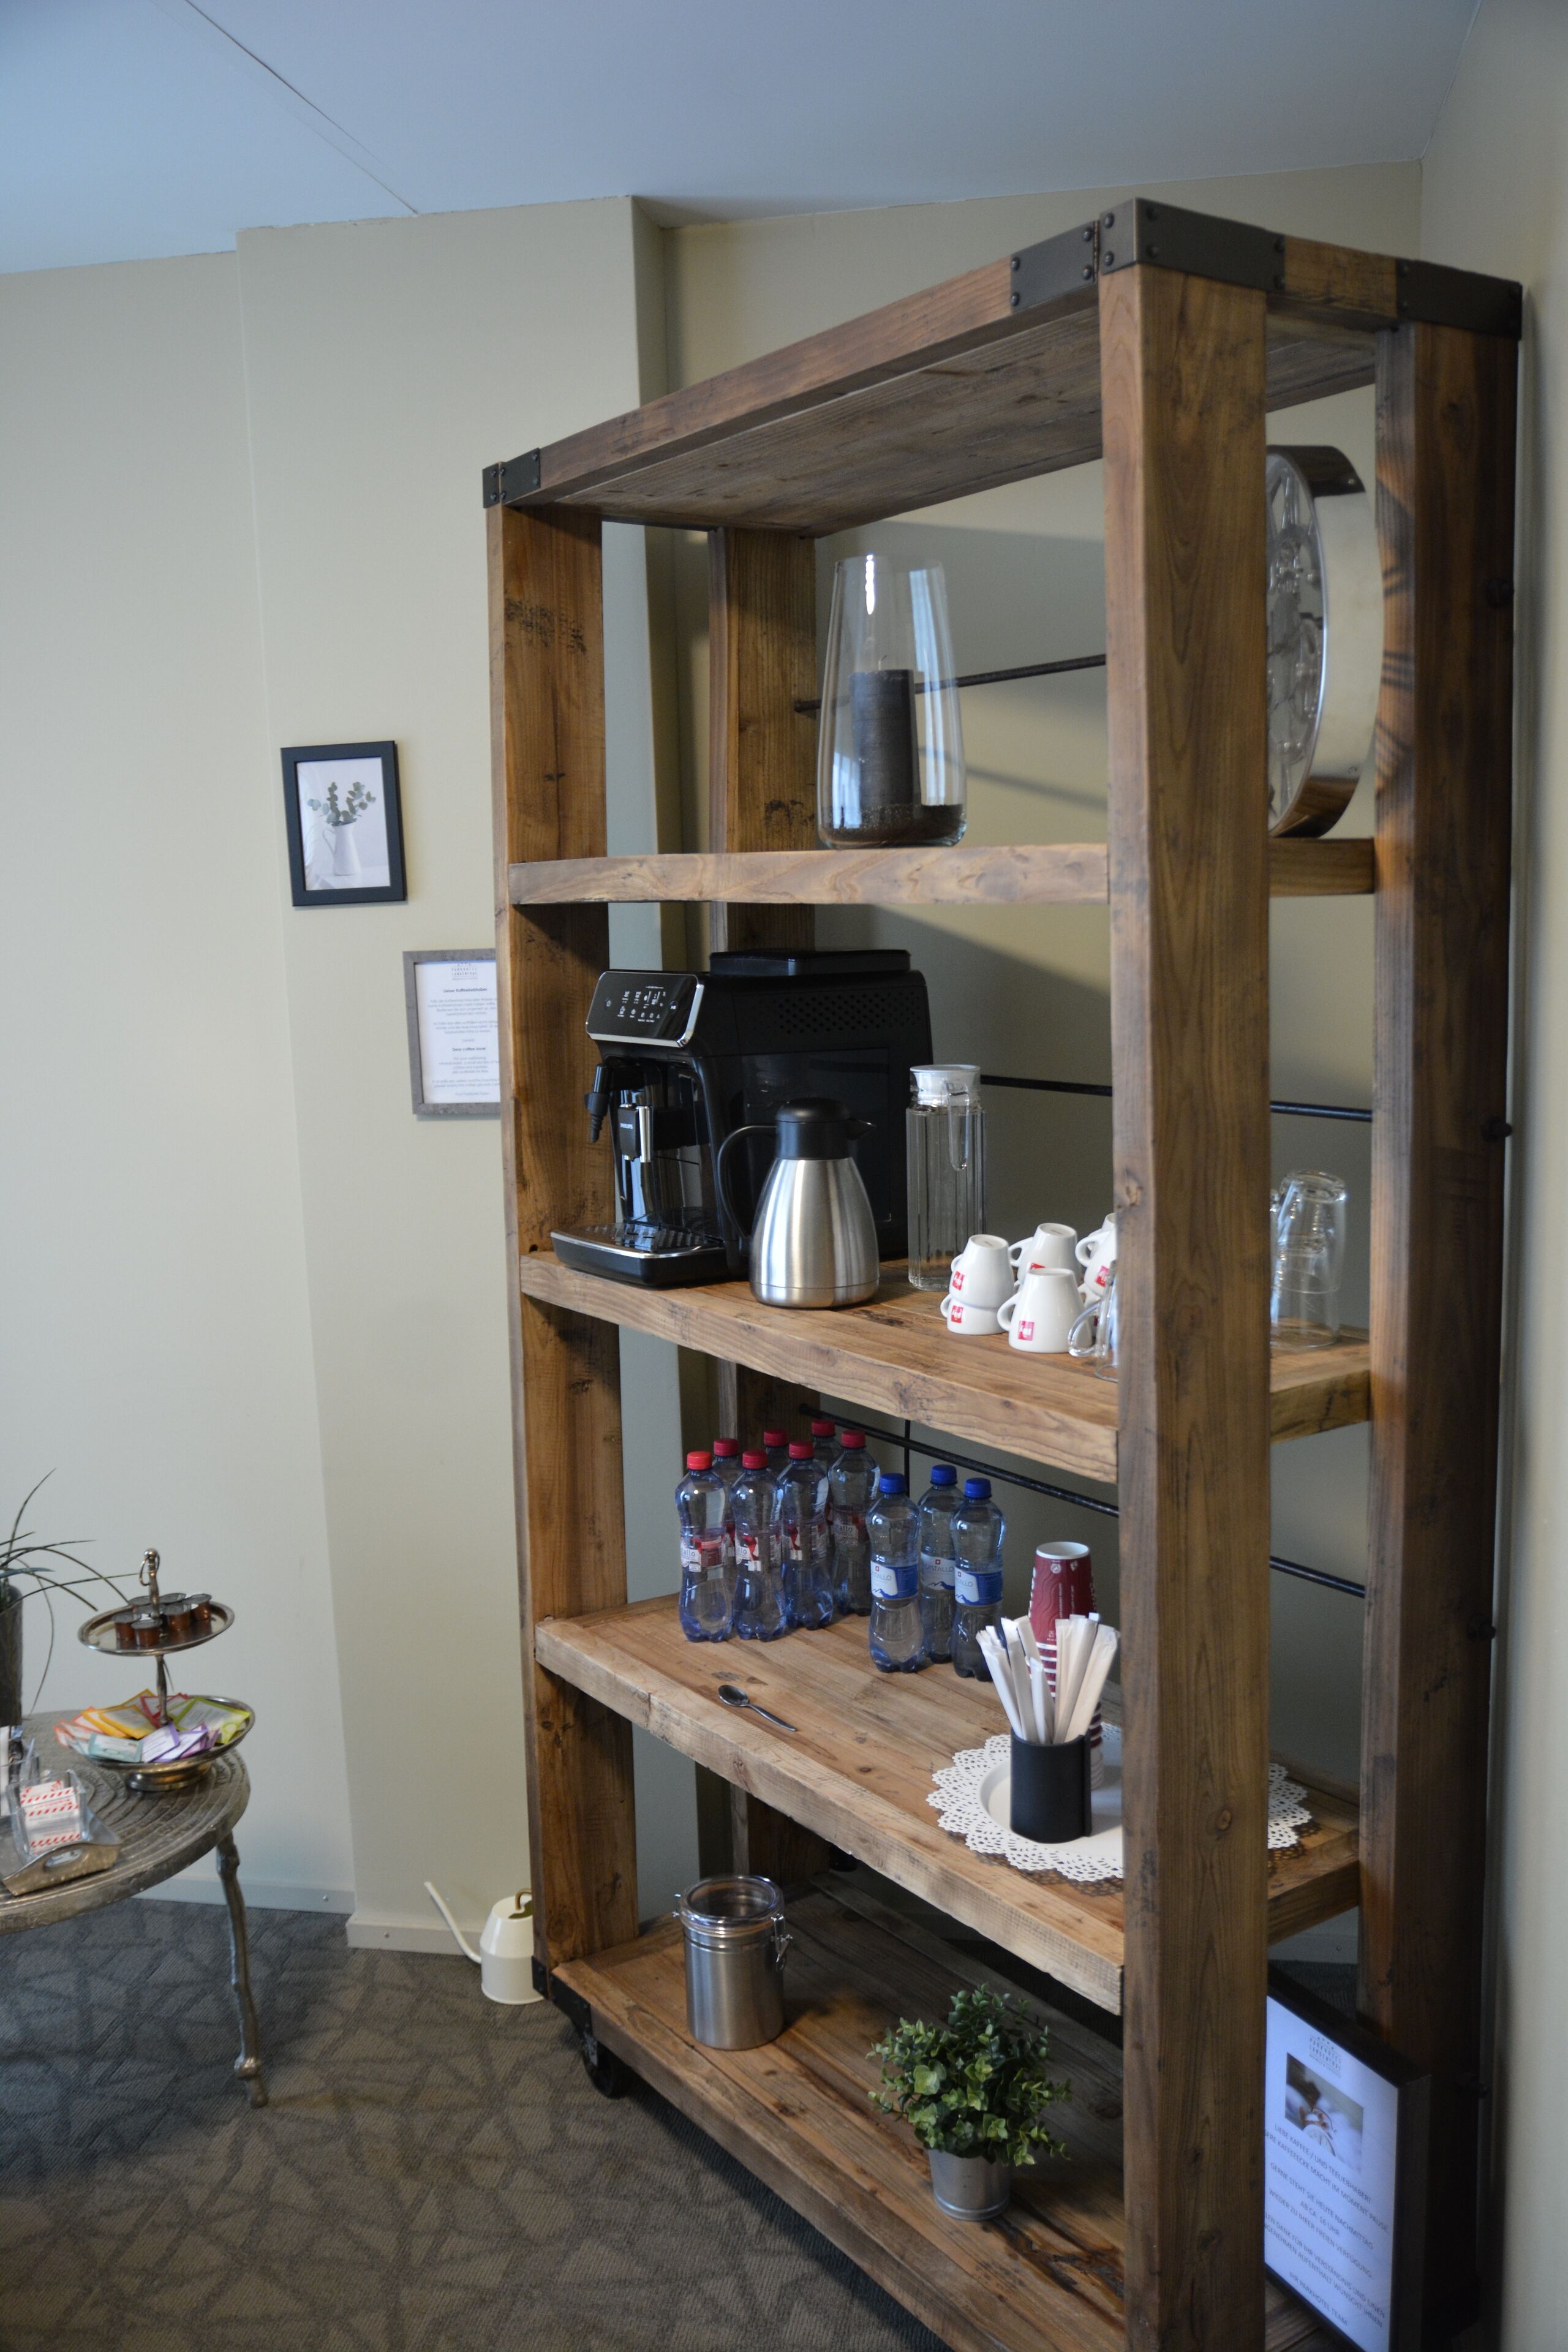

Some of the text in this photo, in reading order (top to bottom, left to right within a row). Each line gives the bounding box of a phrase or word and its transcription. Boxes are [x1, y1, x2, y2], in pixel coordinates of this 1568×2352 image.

[1275, 2123, 1288, 2139] LIEBE
[1314, 2155, 1328, 2169] UND
[1269, 2188, 1289, 2209] WIEDER
[1290, 2206, 1298, 2216] ZU
[1298, 2212, 1314, 2230] IHRER
[1315, 2226, 1335, 2247] FREIEN
[1270, 2162, 1288, 2180] GERNE
[1289, 2177, 1305, 2195] STEHT
[1316, 2198, 1334, 2218] HEUTE
[1335, 2214, 1373, 2250] NACHMITTAG
[1300, 2201, 1308, 2211] AB
[1319, 2216, 1327, 2226] 16
[1327, 2222, 1340, 2236] UHR
[1311, 2166, 1330, 2186] MACHT
[1332, 2184, 1340, 2193] IM
[1341, 2190, 1368, 2216] MOMENT
[1276, 2221, 1291, 2239] DANK
[1303, 2244, 1314, 2256] IHR
[1352, 2286, 1366, 2302] UND
[1367, 2297, 1385, 2319] EINEN
[1289, 2271, 1348, 2326] IHR PARKHOTEL TEAM
[1298, 2252, 1332, 2285] AUFENTHALT
[1363, 2307, 1382, 2329] IHNEN
